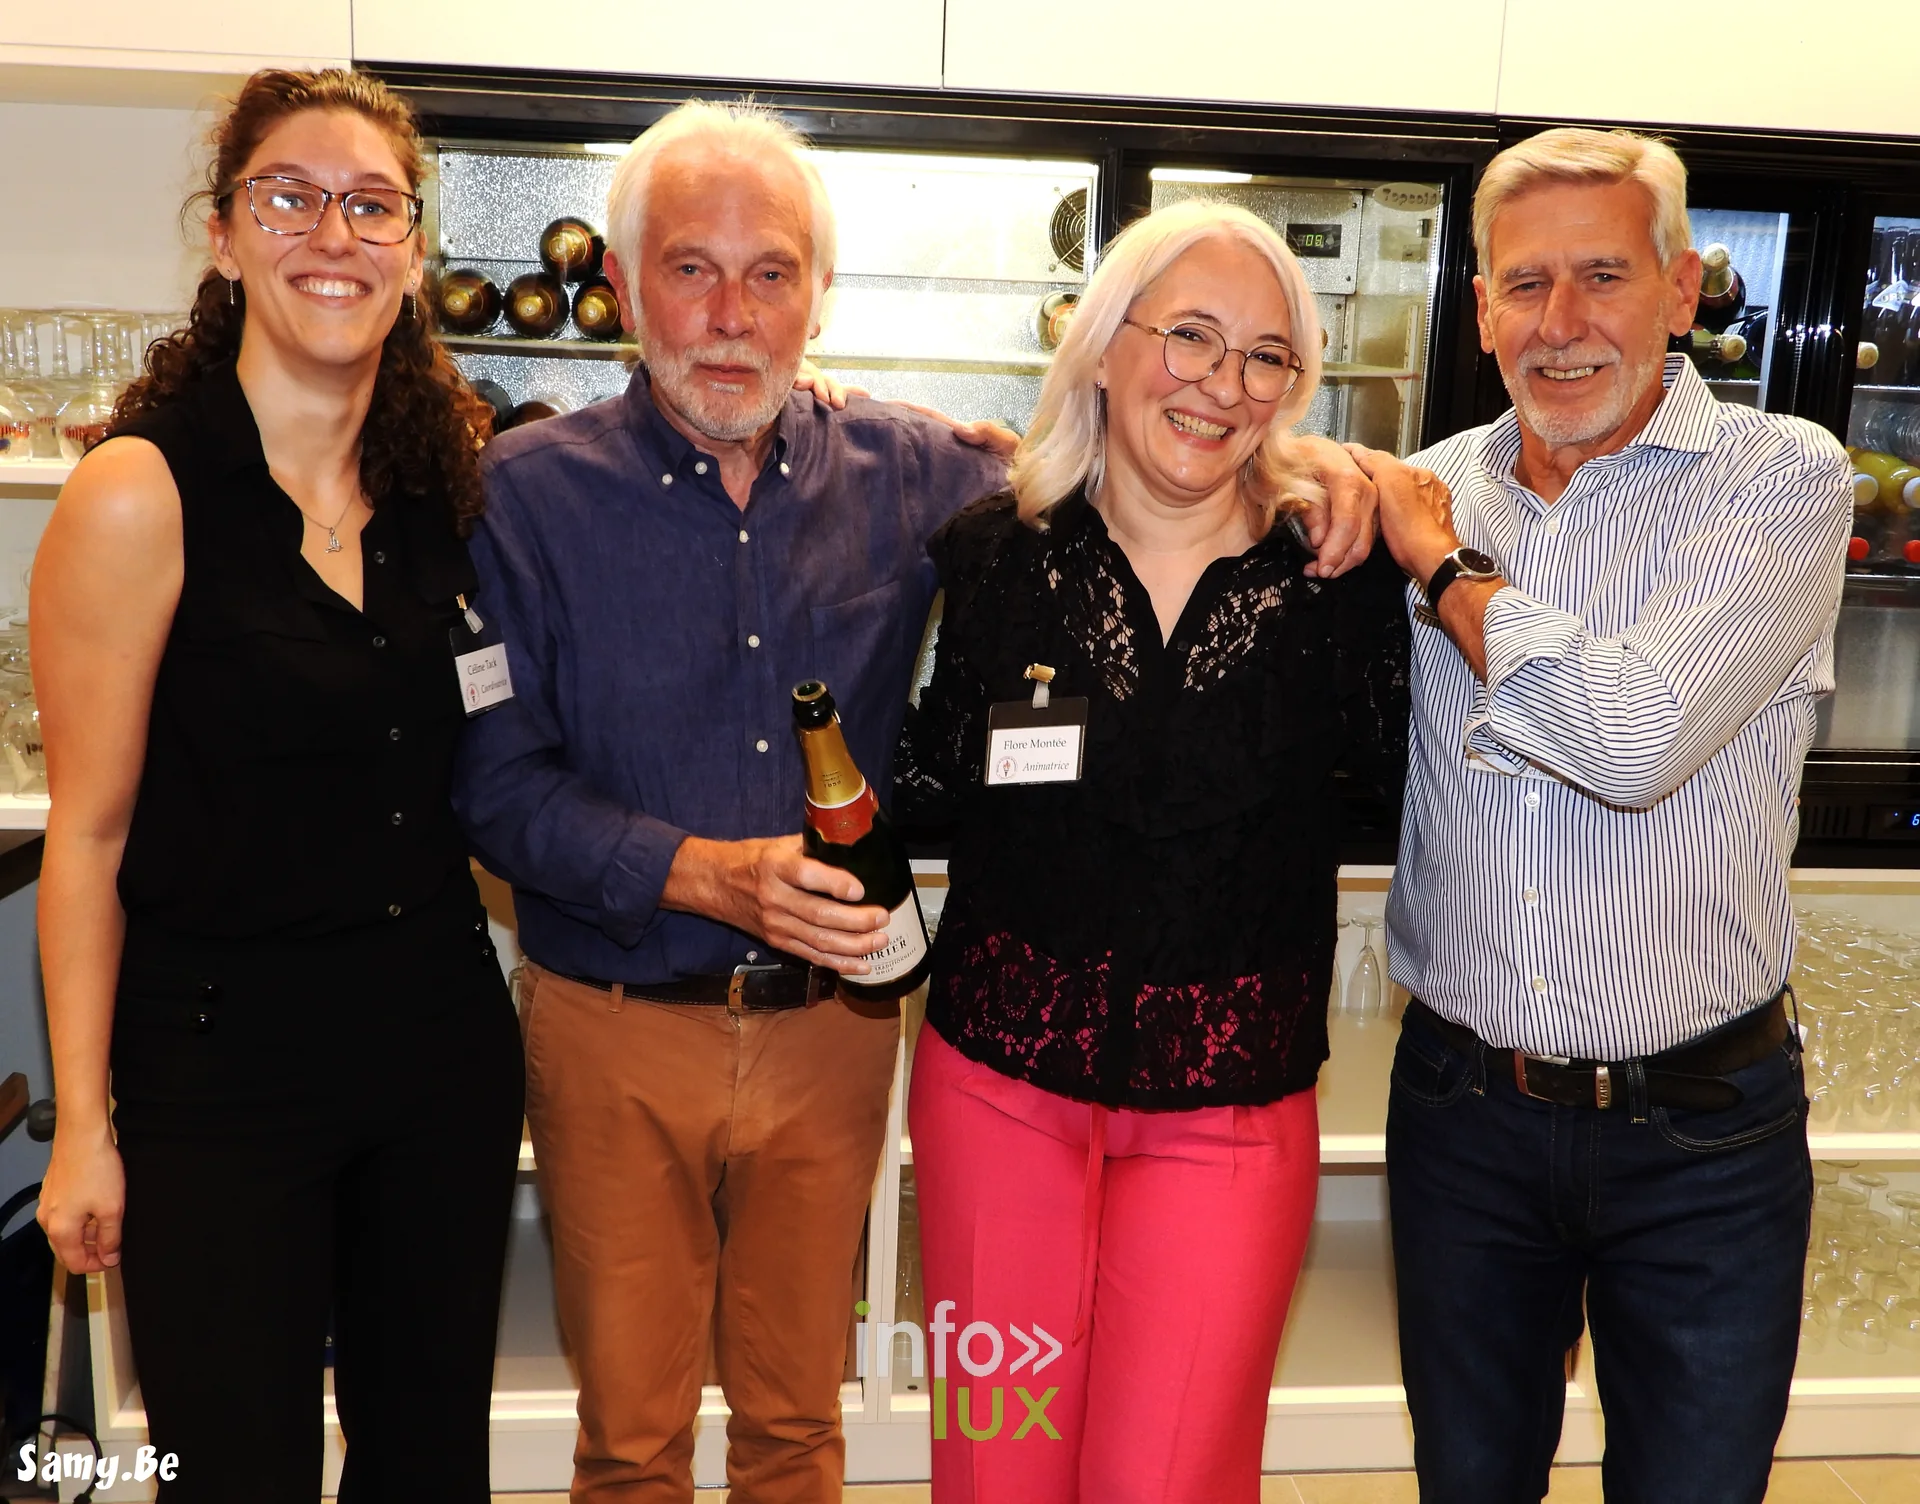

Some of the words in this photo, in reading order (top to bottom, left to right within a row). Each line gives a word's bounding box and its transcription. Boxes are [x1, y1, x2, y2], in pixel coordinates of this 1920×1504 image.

[1003, 739, 1028, 750] Flore
[1030, 737, 1067, 749] Montée
[1021, 760, 1070, 772] Animatrice
